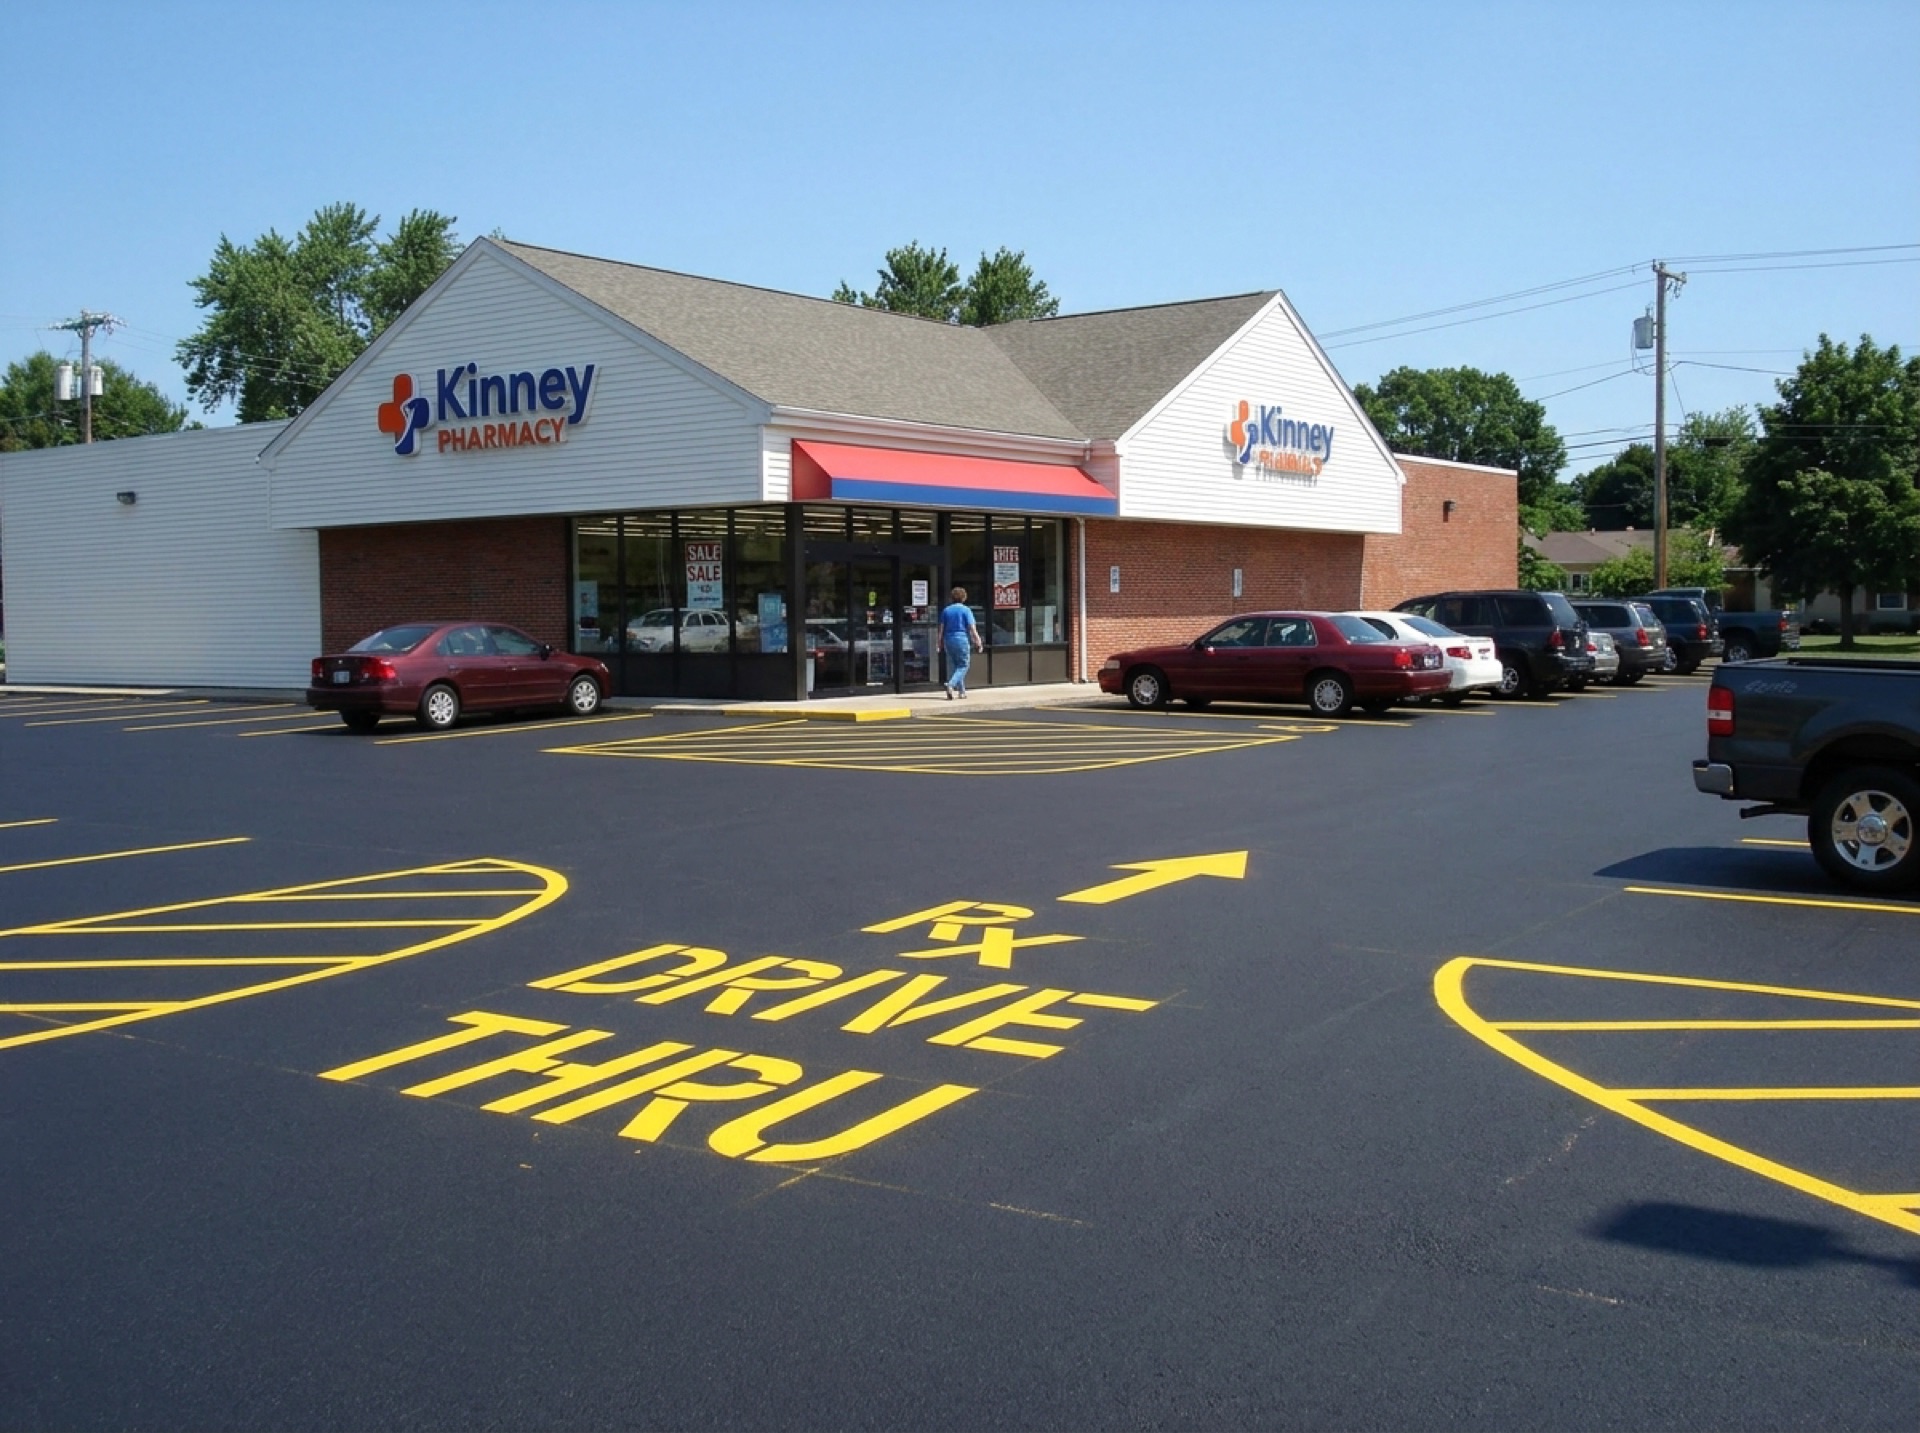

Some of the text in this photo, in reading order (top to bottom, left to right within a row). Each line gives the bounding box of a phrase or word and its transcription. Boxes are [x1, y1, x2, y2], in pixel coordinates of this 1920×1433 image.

[436, 362, 596, 425] Kinney
[438, 416, 566, 453] PHARMACY
[1260, 405, 1334, 463] Kinney
[687, 544, 721, 561] SALE
[687, 565, 721, 582] SALE
[527, 943, 1160, 1060] DRIVE
[318, 1010, 980, 1164] THRU
